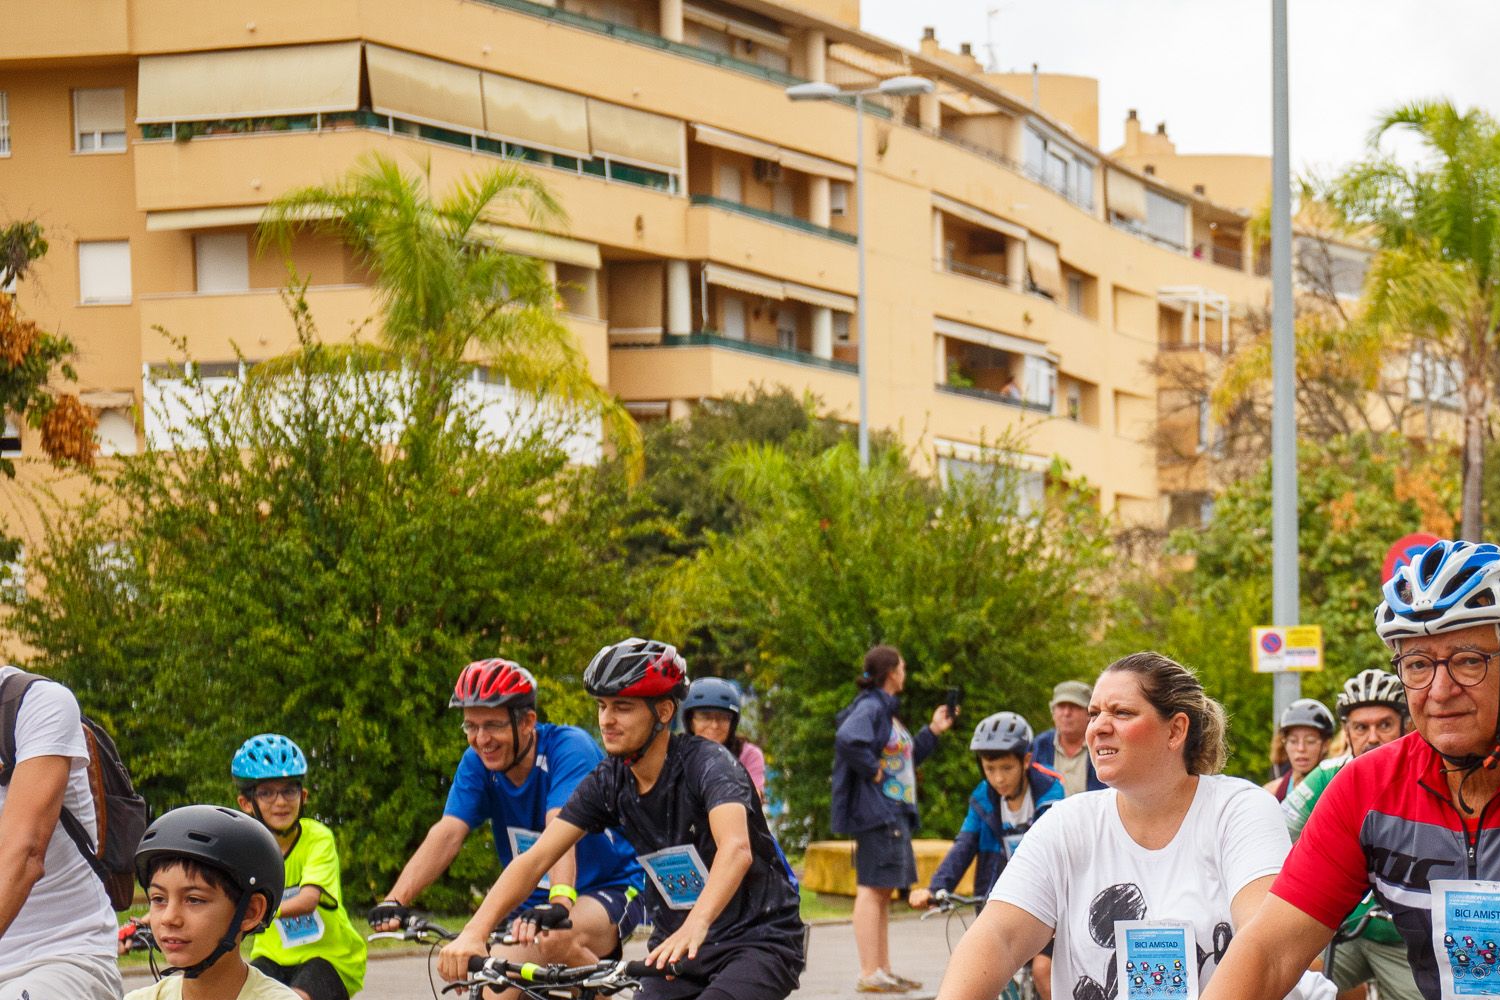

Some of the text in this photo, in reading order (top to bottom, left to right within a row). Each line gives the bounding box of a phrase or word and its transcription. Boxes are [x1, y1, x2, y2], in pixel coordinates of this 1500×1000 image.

[1455, 909, 1471, 918] BICI
[1134, 941, 1179, 949] BICI AMISTAD
